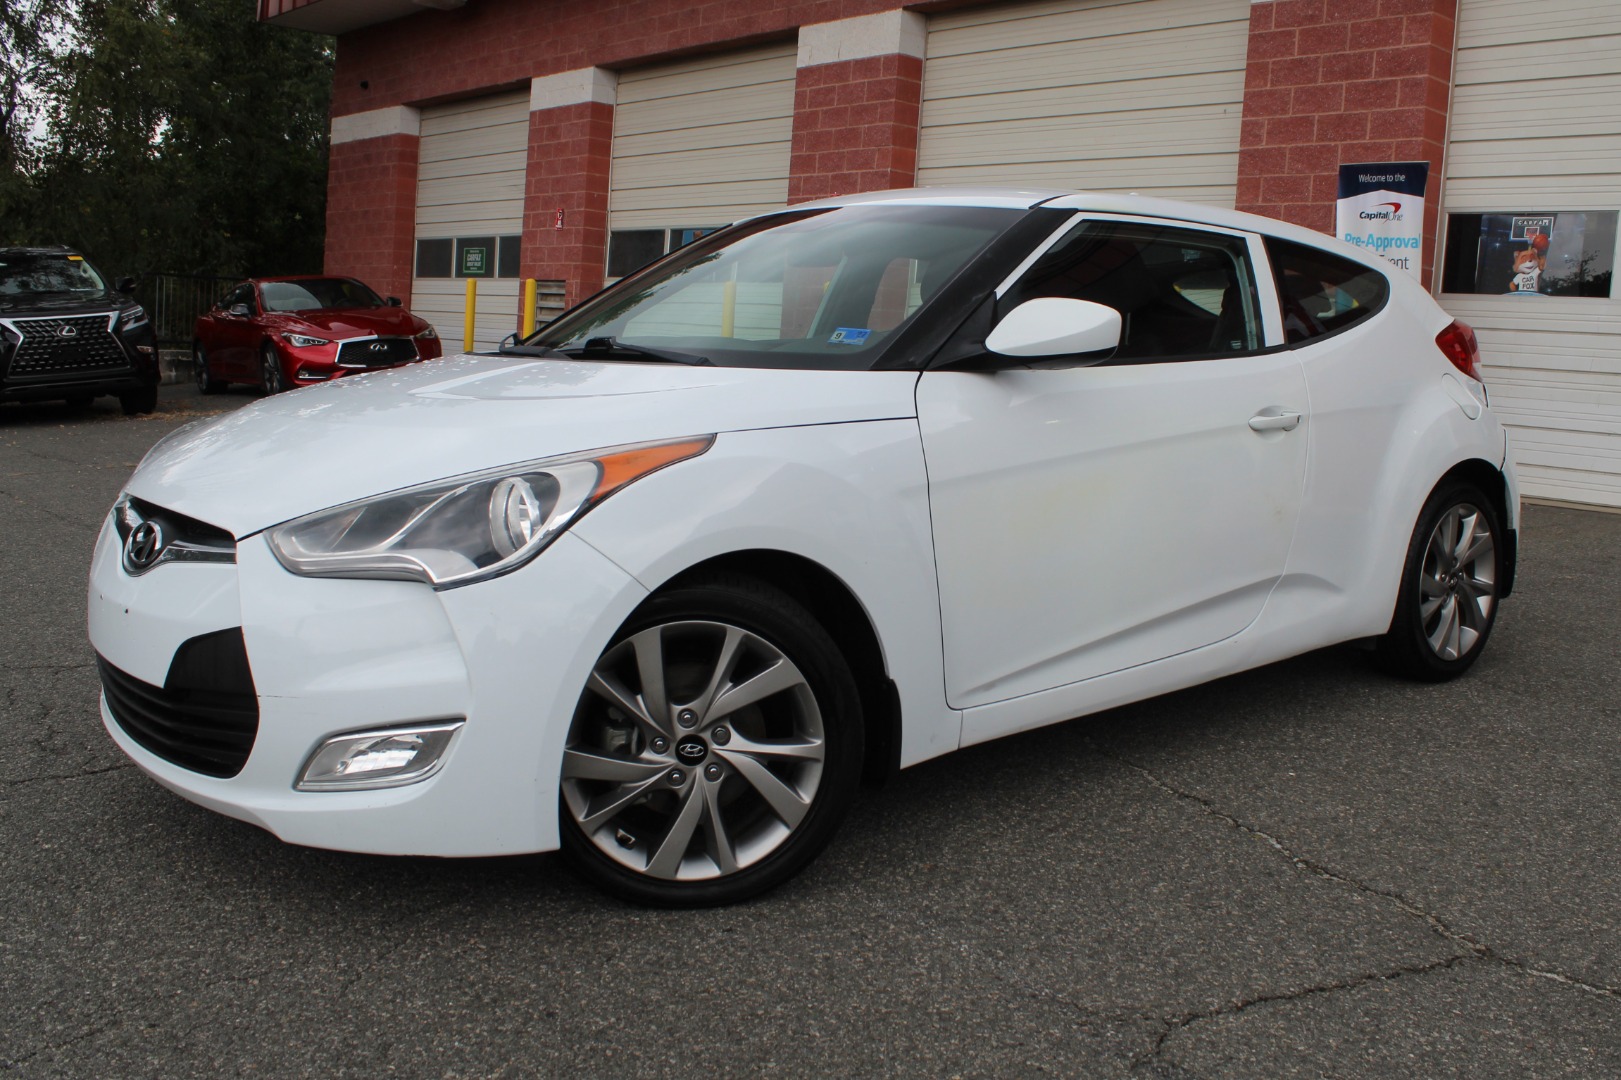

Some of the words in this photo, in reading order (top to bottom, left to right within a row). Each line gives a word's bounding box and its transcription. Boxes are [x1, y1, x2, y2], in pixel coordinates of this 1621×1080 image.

[1358, 174, 1386, 182] Welcome
[1386, 174, 1394, 182] to
[1394, 173, 1406, 182] the
